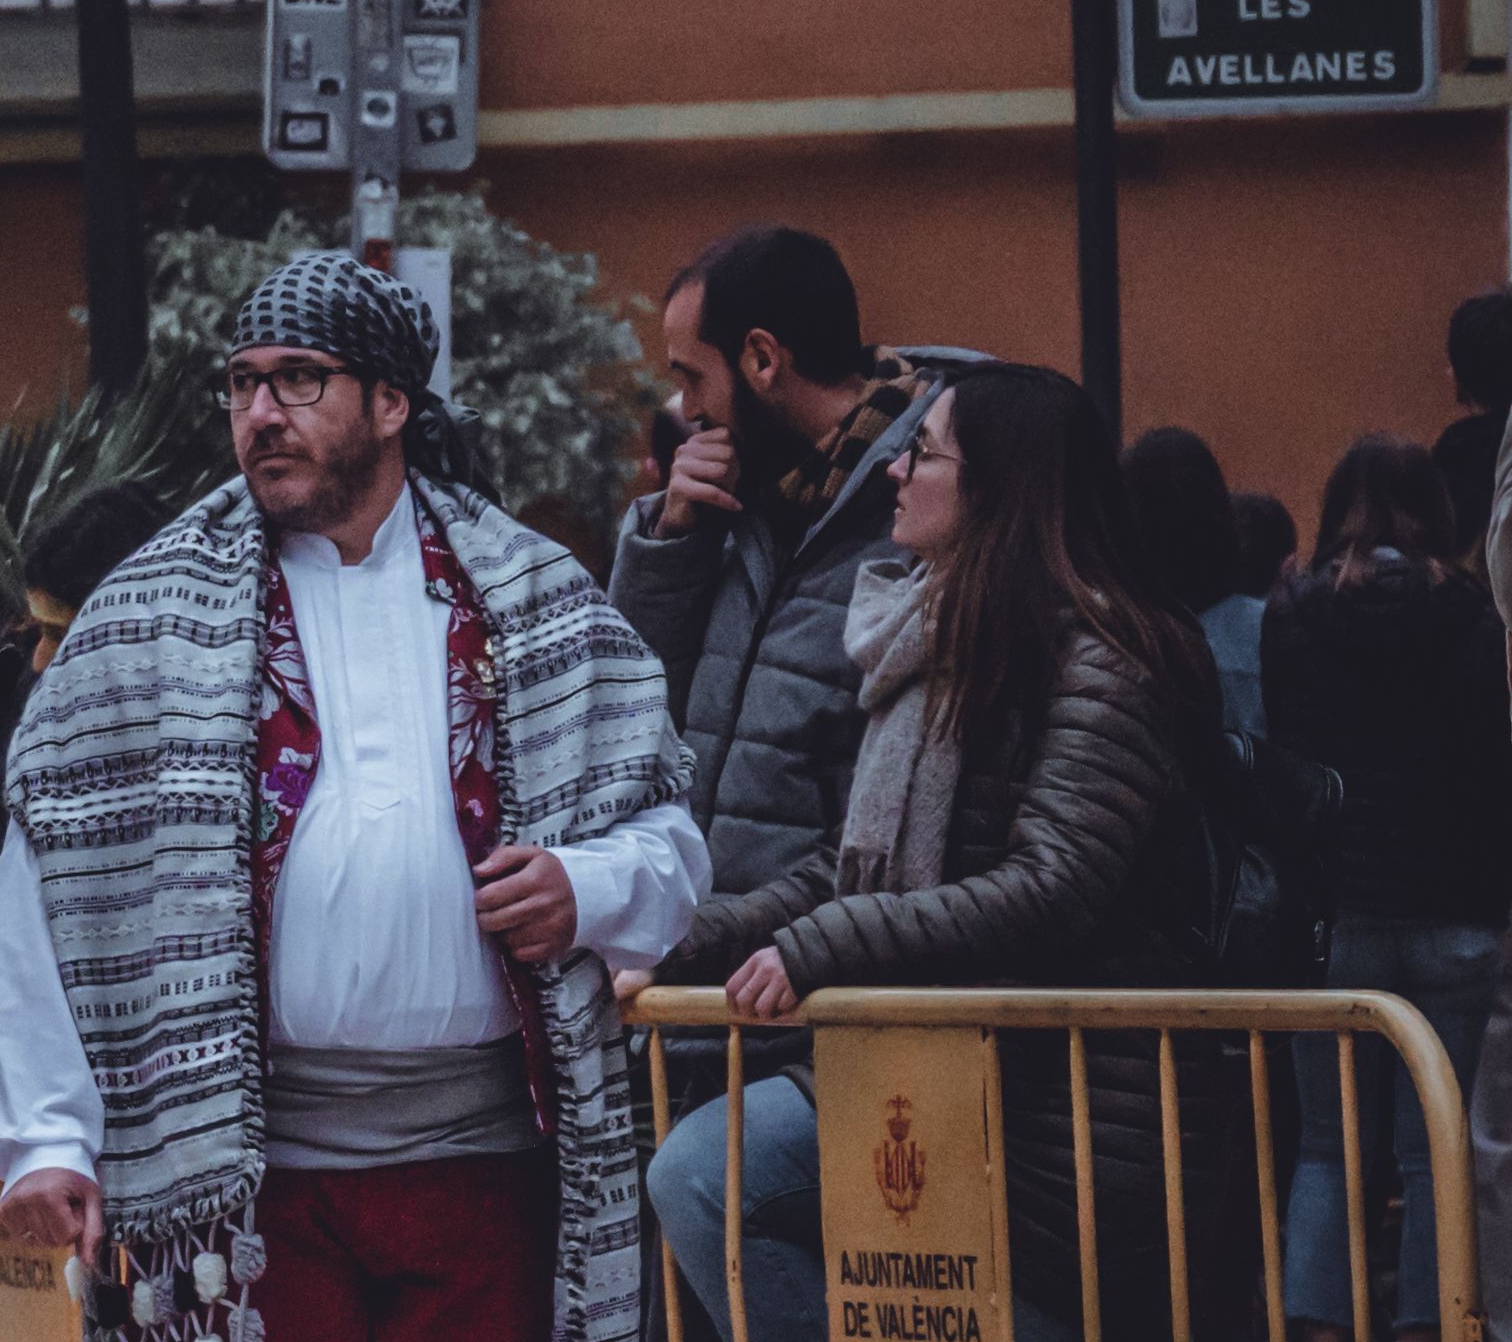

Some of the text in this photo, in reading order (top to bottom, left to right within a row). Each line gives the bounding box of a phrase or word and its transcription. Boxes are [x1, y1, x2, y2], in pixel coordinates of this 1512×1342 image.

[1166, 51, 1396, 87] AVELLANES
[841, 1251, 977, 1291] AJUNTAMENT
[843, 1301, 871, 1339] DE
